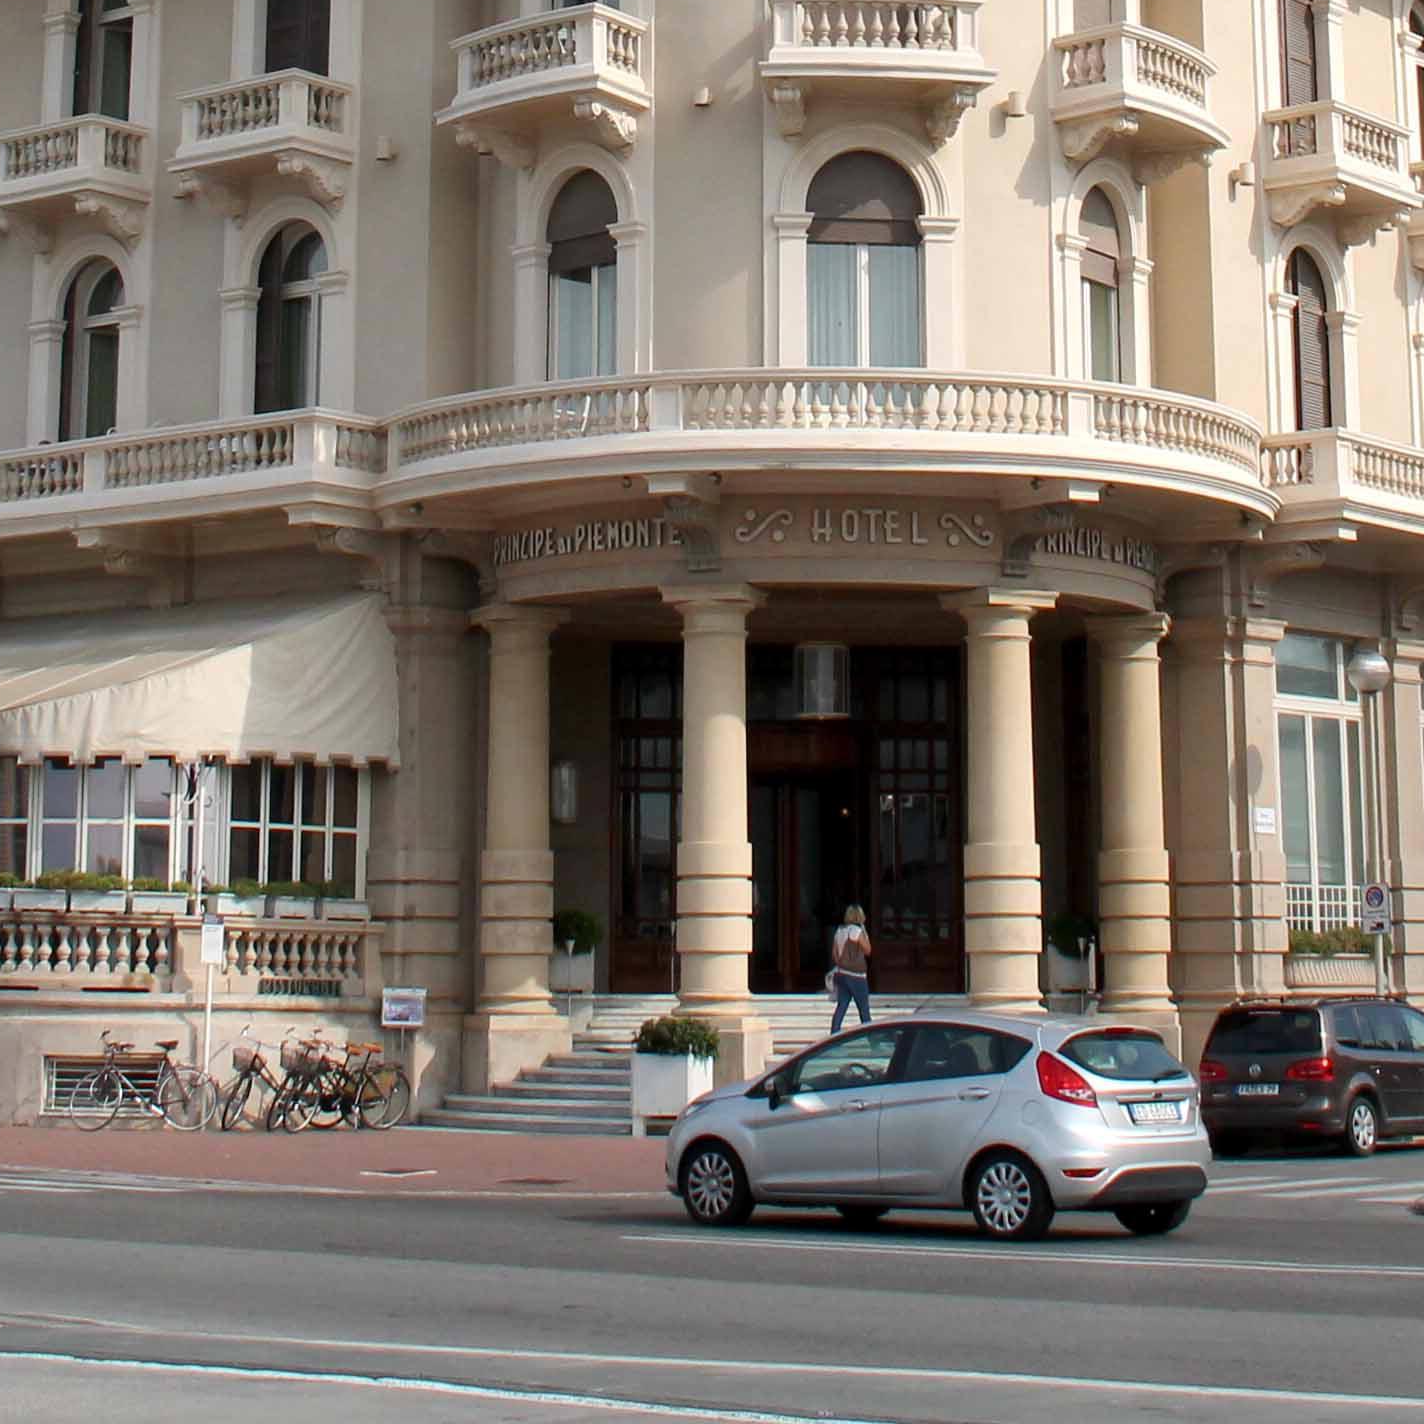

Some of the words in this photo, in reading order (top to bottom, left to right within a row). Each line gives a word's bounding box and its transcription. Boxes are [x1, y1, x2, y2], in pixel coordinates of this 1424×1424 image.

[493, 529, 555, 567] PRINCIPE
[576, 519, 682, 554] PIEMONTE
[811, 507, 929, 544] HOTEL
